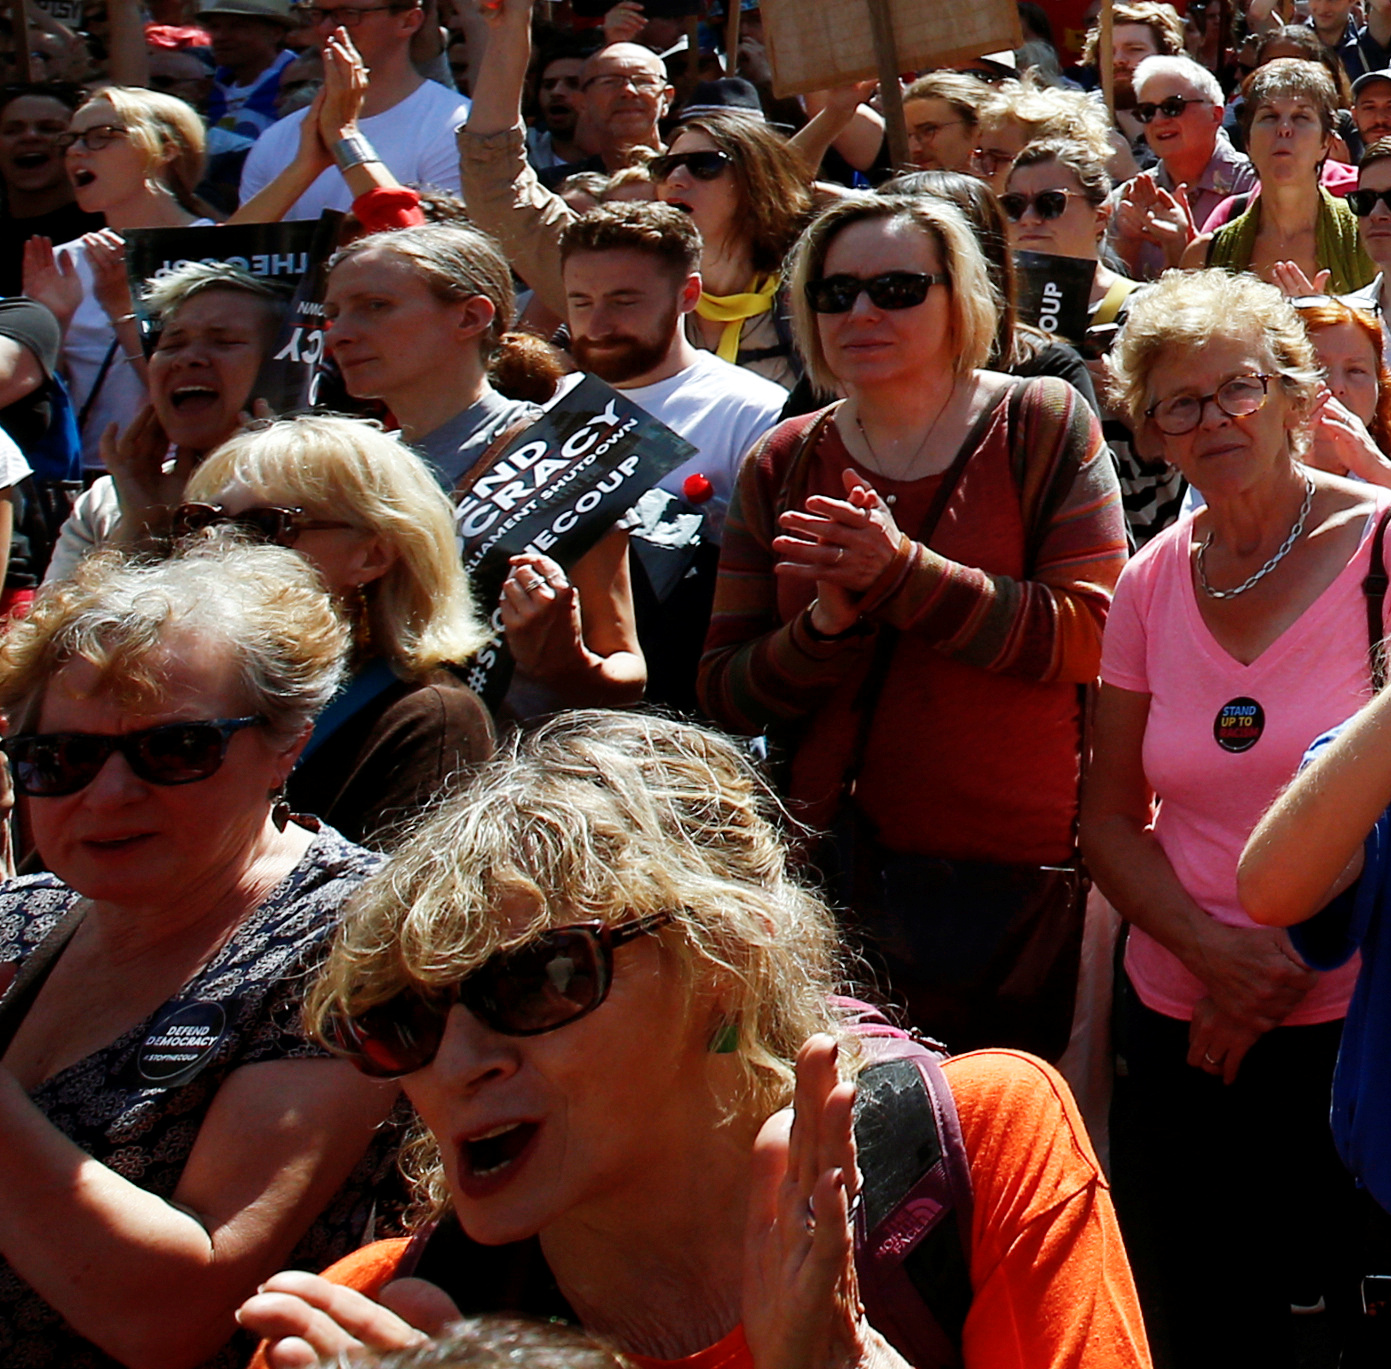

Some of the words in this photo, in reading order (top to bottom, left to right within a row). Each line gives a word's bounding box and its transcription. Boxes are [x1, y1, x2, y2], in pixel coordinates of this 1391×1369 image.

[540, 417, 639, 501] SHUTDOWN
[1222, 705, 1257, 717] STAND
[1221, 717, 1236, 727] UP
[1238, 716, 1253, 727] TO
[165, 1025, 210, 1036] DEFEND
[146, 1036, 218, 1047] DEMOCRACY
